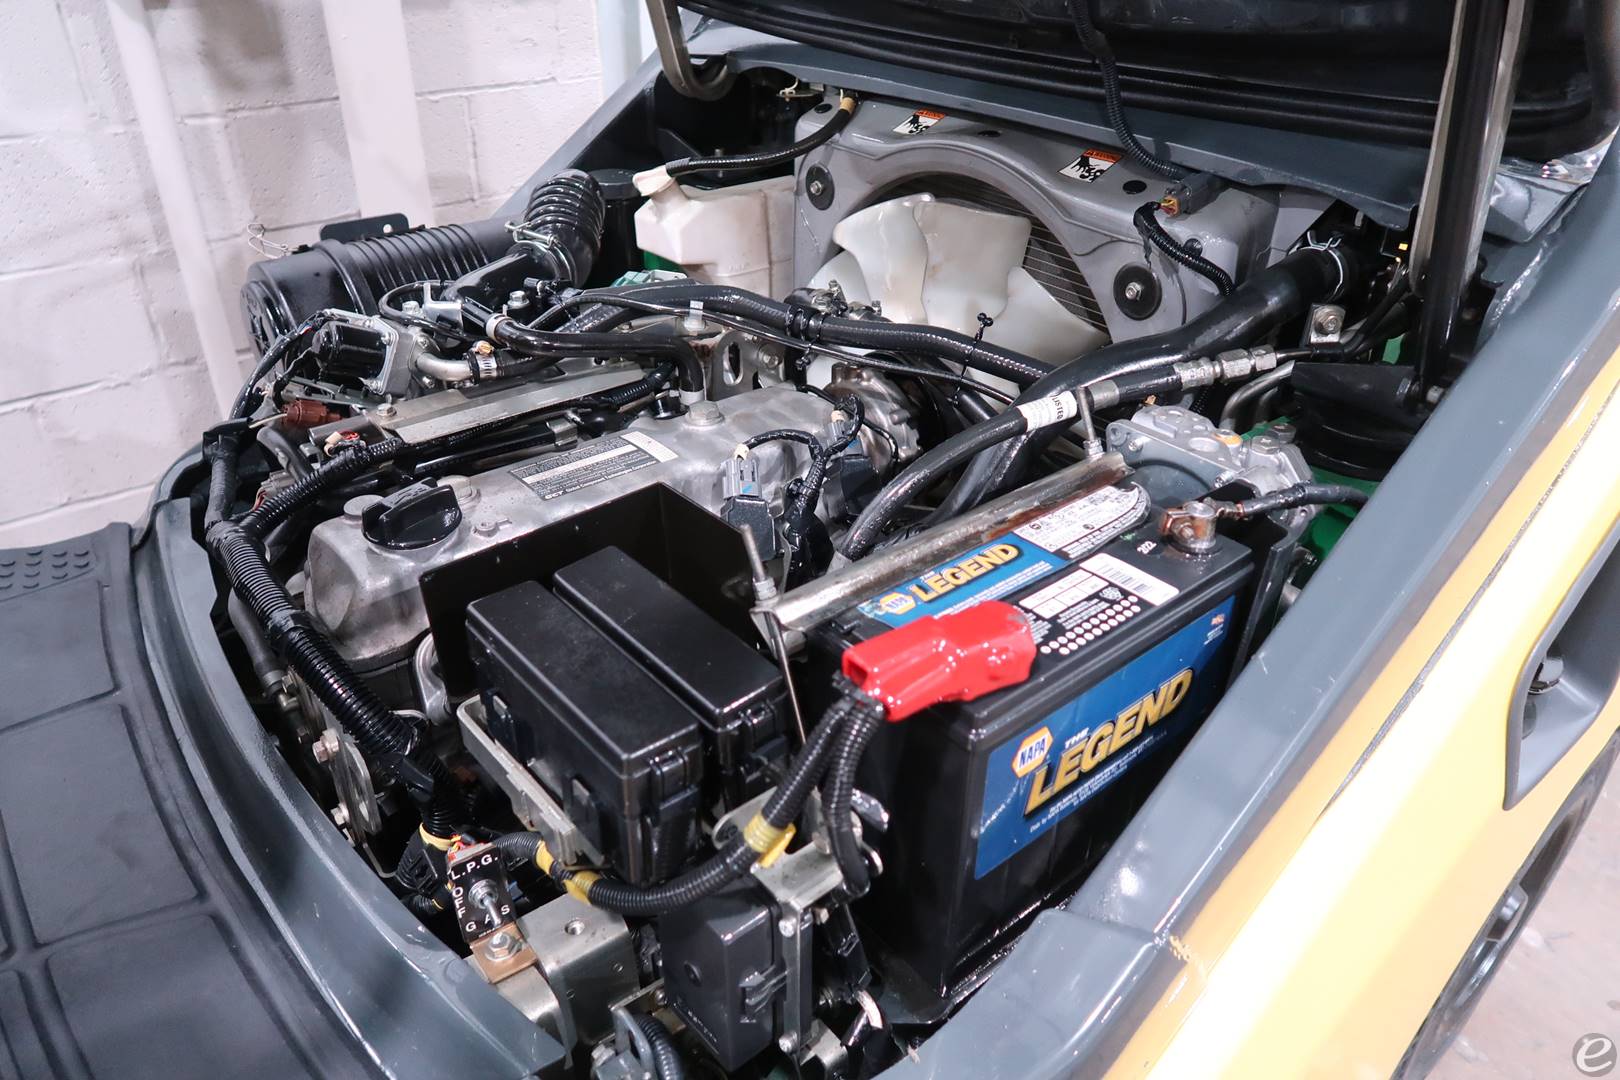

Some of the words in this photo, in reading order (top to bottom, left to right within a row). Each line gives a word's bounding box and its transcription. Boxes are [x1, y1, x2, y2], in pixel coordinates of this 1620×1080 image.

[911, 544, 1020, 602] LEGEND
[1018, 737, 1048, 769] NAPA
[1024, 666, 1194, 817] LEGEND
[1065, 727, 1090, 749] THE
[452, 886, 466, 919] OFF
